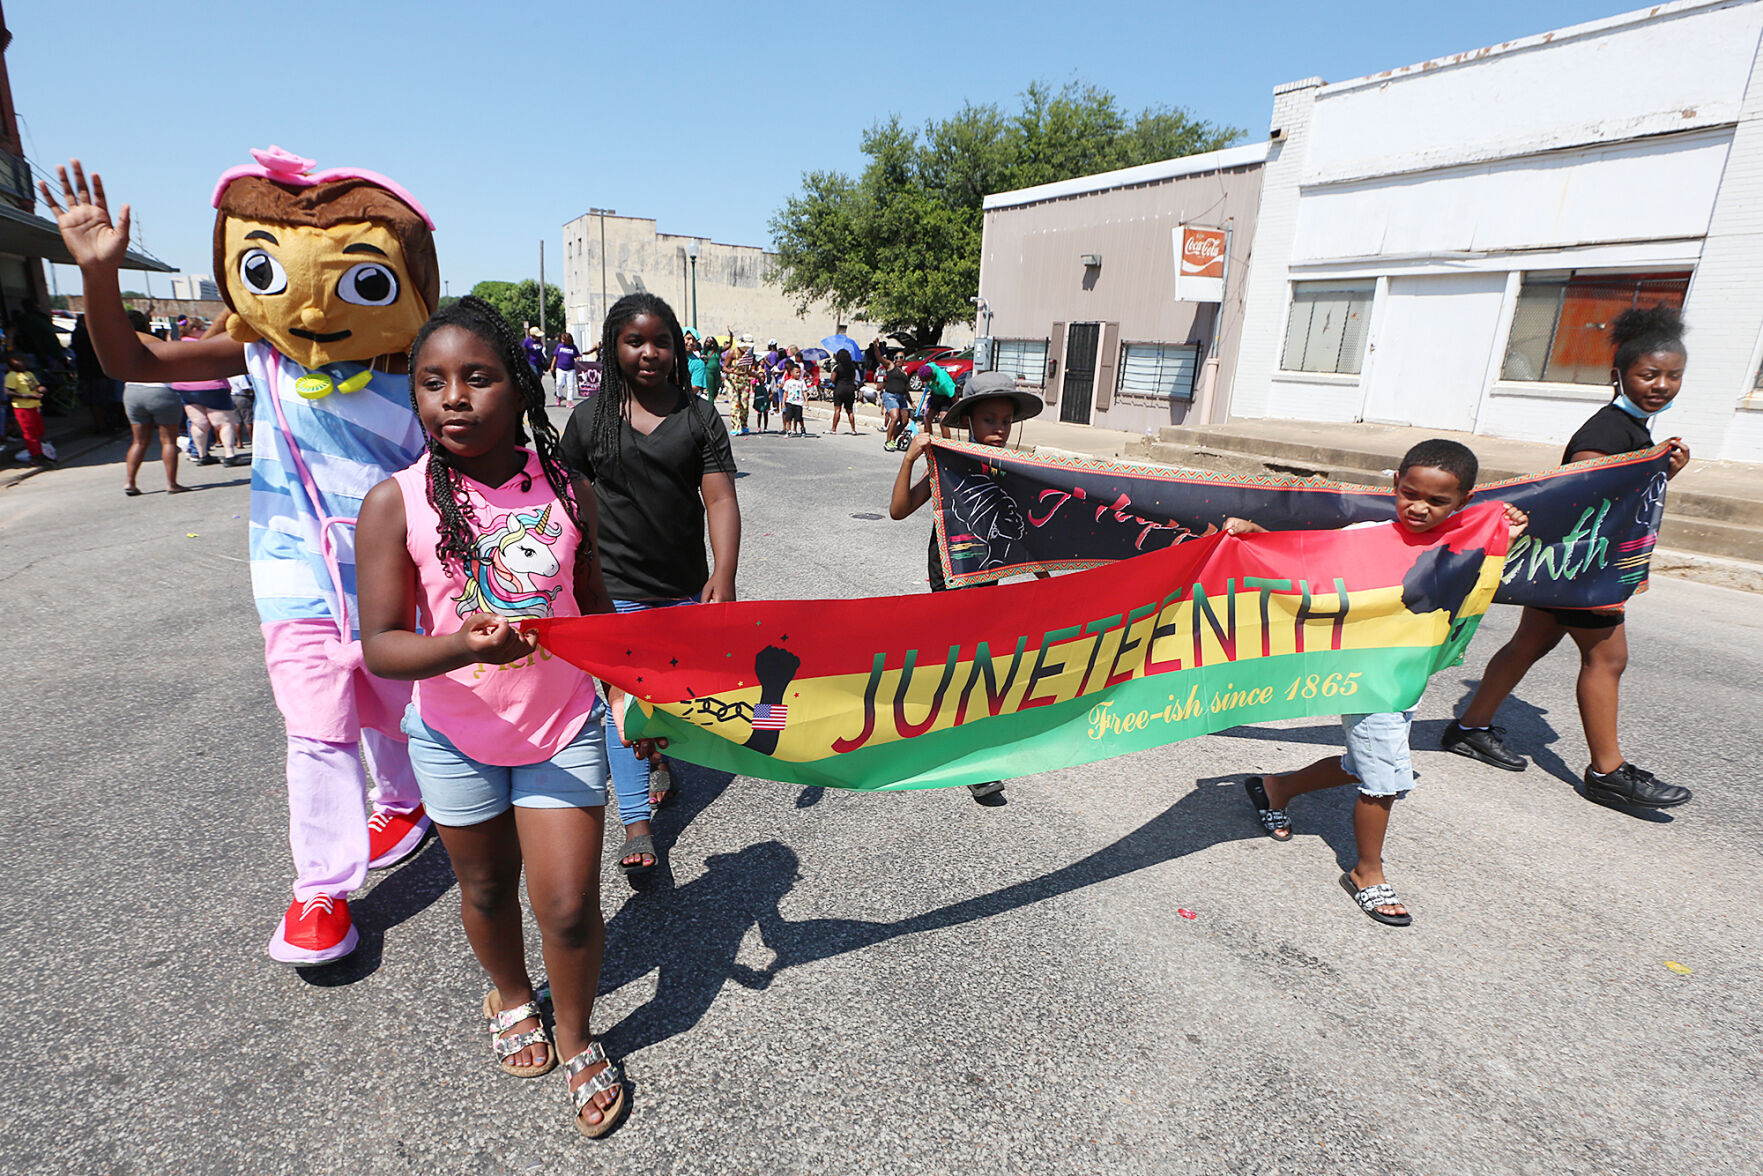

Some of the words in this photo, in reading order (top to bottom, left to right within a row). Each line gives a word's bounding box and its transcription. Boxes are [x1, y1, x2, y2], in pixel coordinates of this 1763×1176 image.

[831, 577, 1350, 754] JUNETEENTH
[1087, 684, 1205, 740] Free-ish
[1210, 683, 1273, 715] since
[1284, 672, 1363, 701] 1865
